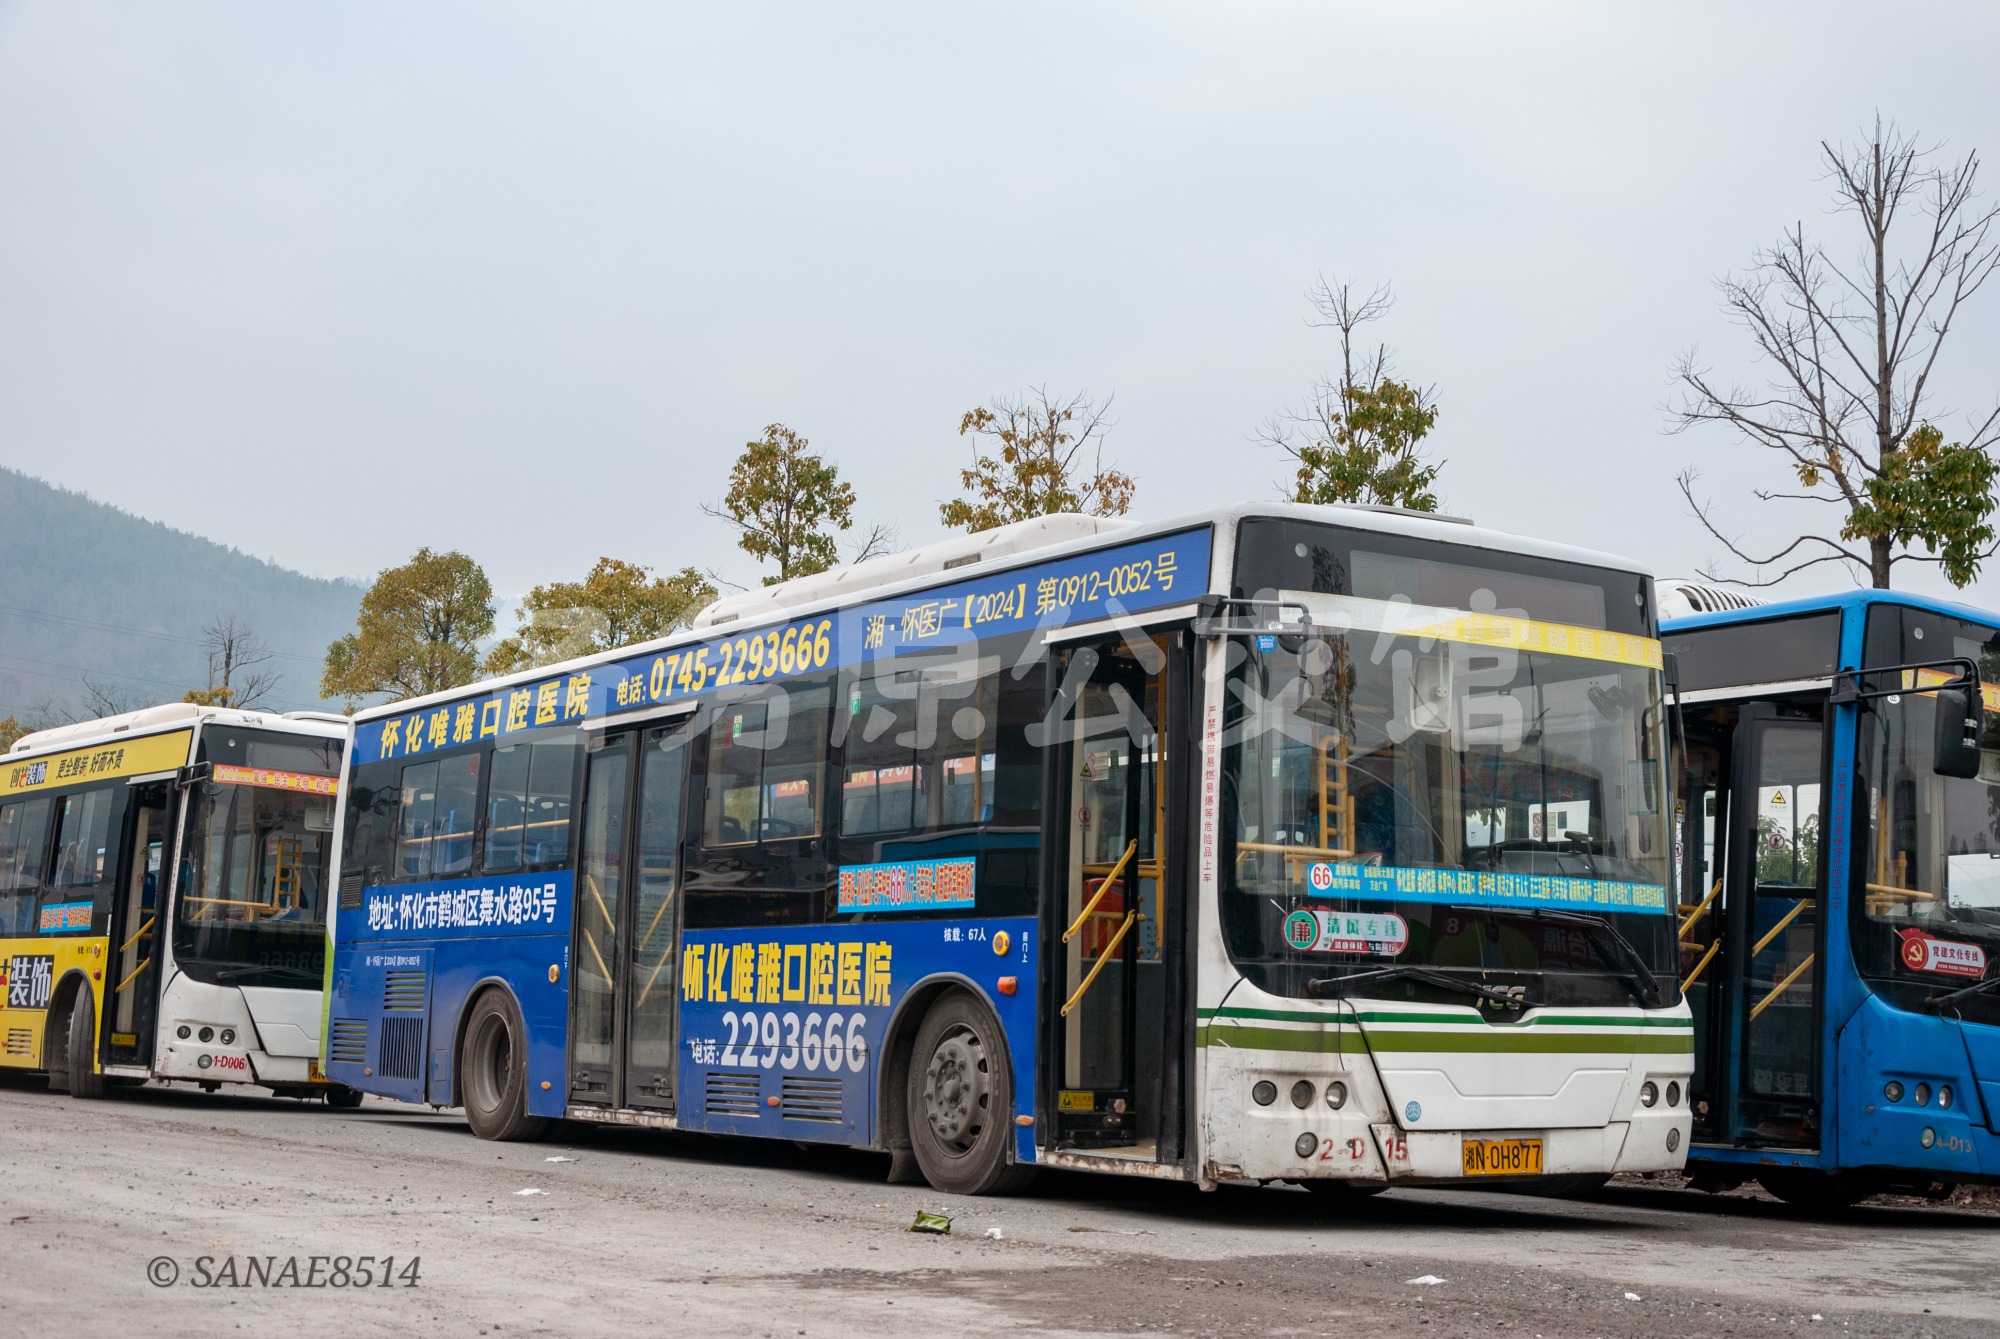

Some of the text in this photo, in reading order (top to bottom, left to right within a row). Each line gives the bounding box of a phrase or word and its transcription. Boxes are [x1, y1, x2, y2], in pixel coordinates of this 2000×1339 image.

[380, 672, 592, 759] 怀化唯雅口腔医院
[1203, 705, 1217, 883] 严禁携带易燃易爆等危险品上车
[1313, 866, 1331, 886] 66
[1326, 916, 1398, 938] 清风专线
[1932, 945, 1979, 962] 党建文化专线
[682, 941, 893, 1006] 怀化唯雅口腔医院
[721, 1010, 868, 1073] 2293666
